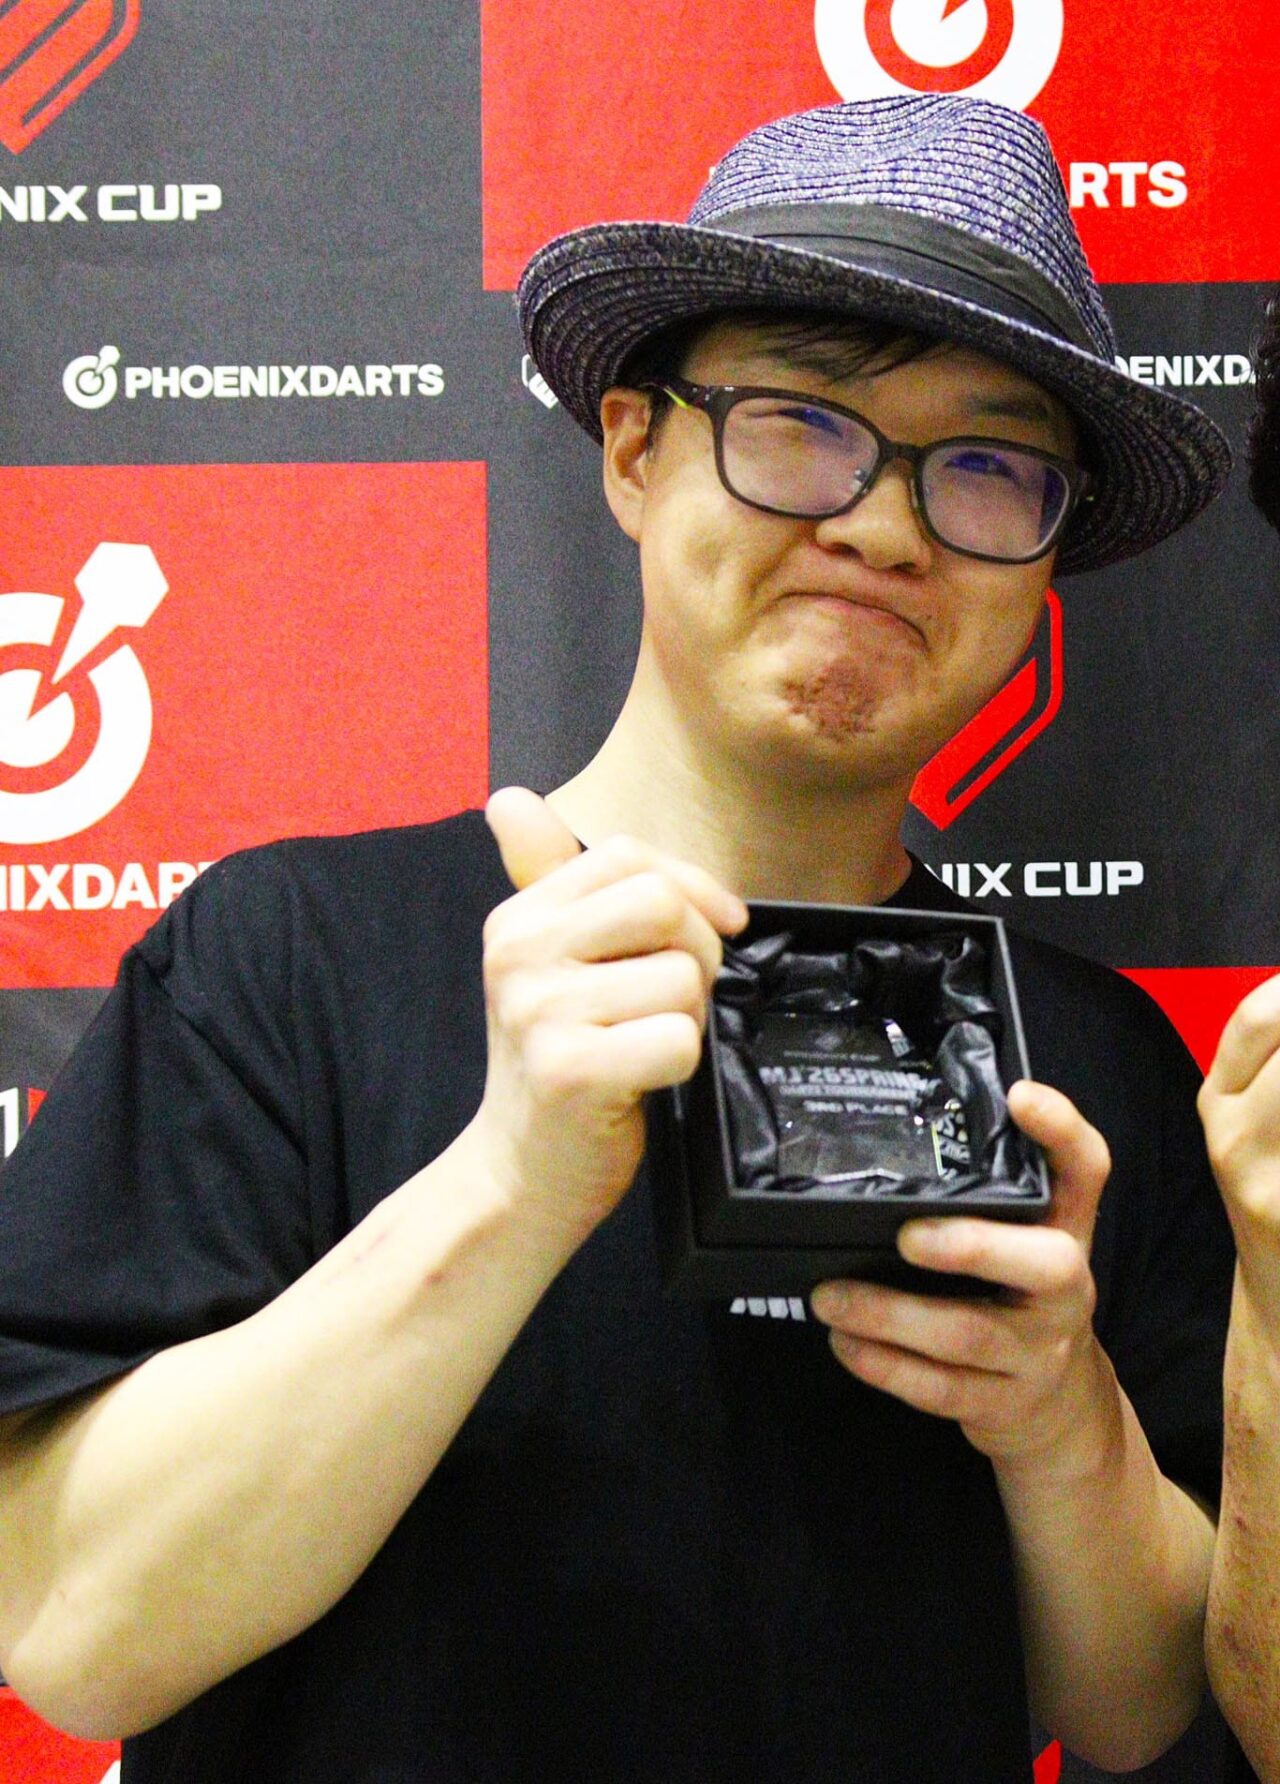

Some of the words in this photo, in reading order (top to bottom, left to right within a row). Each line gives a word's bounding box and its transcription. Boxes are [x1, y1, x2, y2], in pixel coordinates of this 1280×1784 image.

[0, 185, 88, 223] NIX
[97, 183, 223, 222] CUP
[1070, 160, 1188, 208] RTS
[124, 364, 445, 399] PHOENIXDARTS
[1115, 354, 1256, 387] ENIXD
[0, 861, 216, 912] IXDAR
[1024, 861, 1144, 897] CUP
